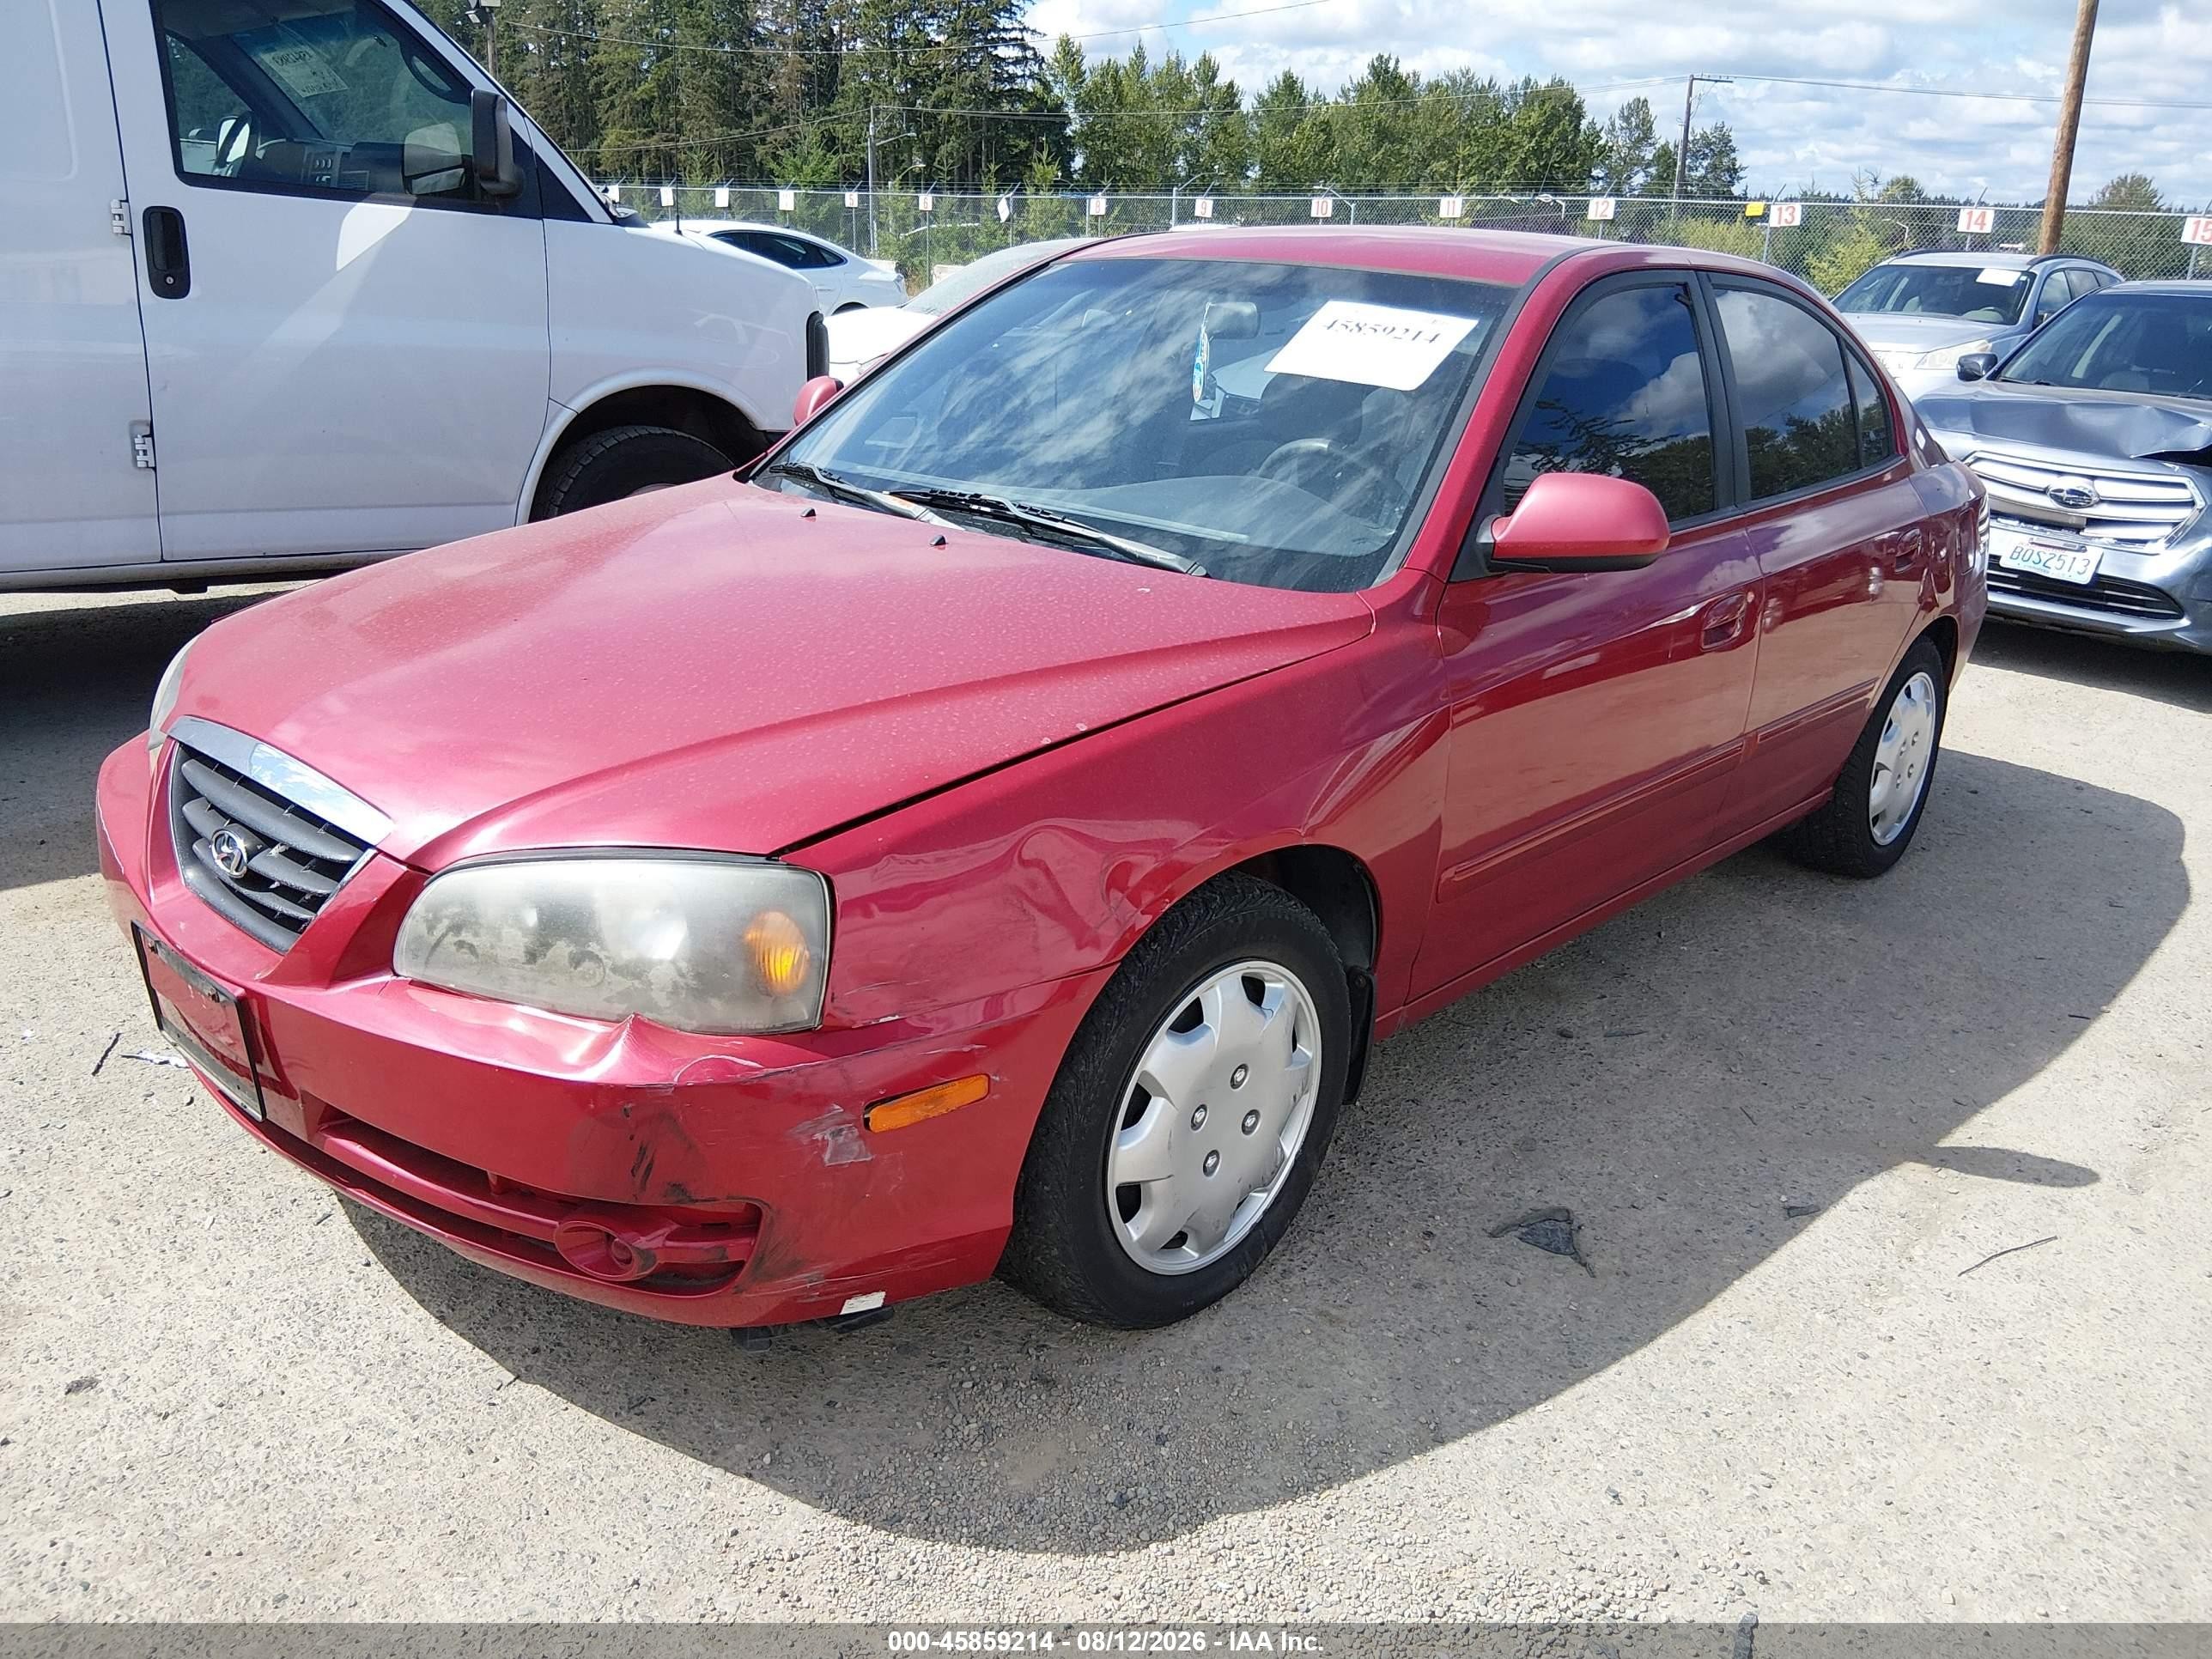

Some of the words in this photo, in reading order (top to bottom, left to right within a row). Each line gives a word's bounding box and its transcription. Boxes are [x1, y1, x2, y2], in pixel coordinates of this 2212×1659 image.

[848, 193, 854, 206] 5
[923, 197, 928, 209] 6
[1095, 200, 1101, 214] 8
[1201, 201, 1206, 216] 9
[1316, 200, 1328, 216] 10
[1445, 200, 1455, 216] 11
[1595, 200, 1609, 217] 12
[1777, 205, 1796, 225] 13
[1966, 210, 1987, 231] 14
[1323, 319, 1441, 343] 45859214
